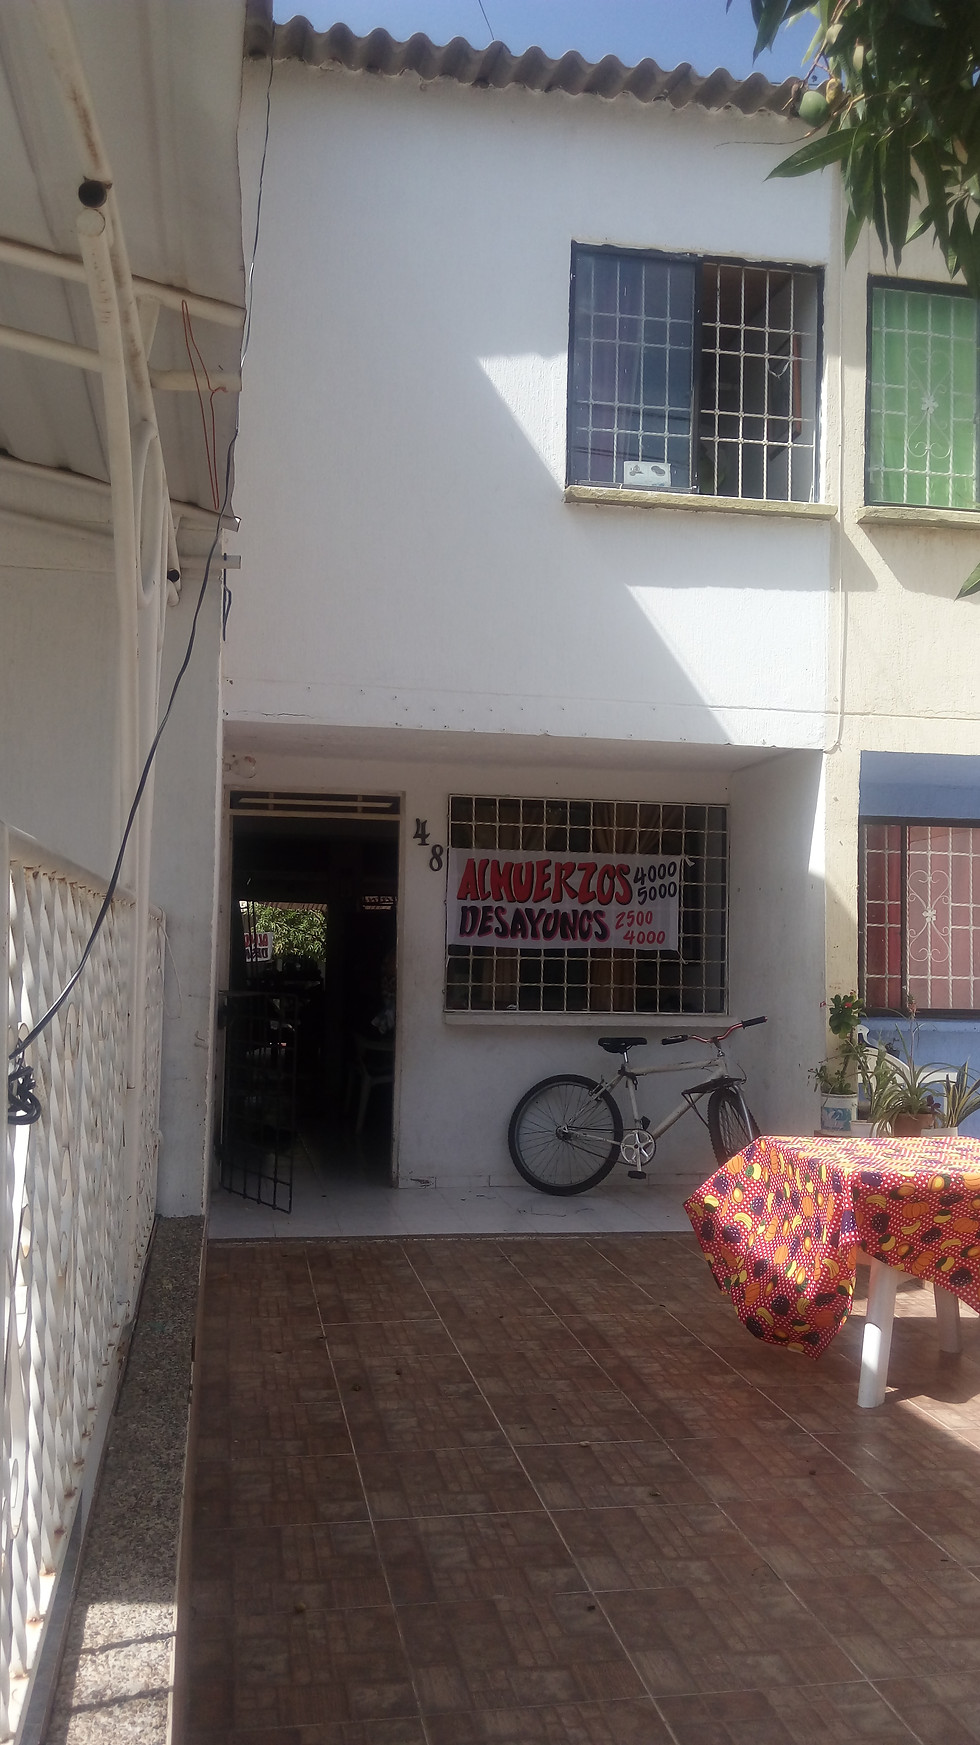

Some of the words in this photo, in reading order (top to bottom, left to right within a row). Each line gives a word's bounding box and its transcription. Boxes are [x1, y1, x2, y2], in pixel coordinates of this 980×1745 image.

[456, 858, 633, 905] ALMUERZOS
[633, 861, 677, 886] 4000
[637, 882, 677, 905] 5000
[458, 906, 611, 942] DESAYUNOS
[615, 911, 653, 930] 2500
[623, 930, 666, 945] 4000
